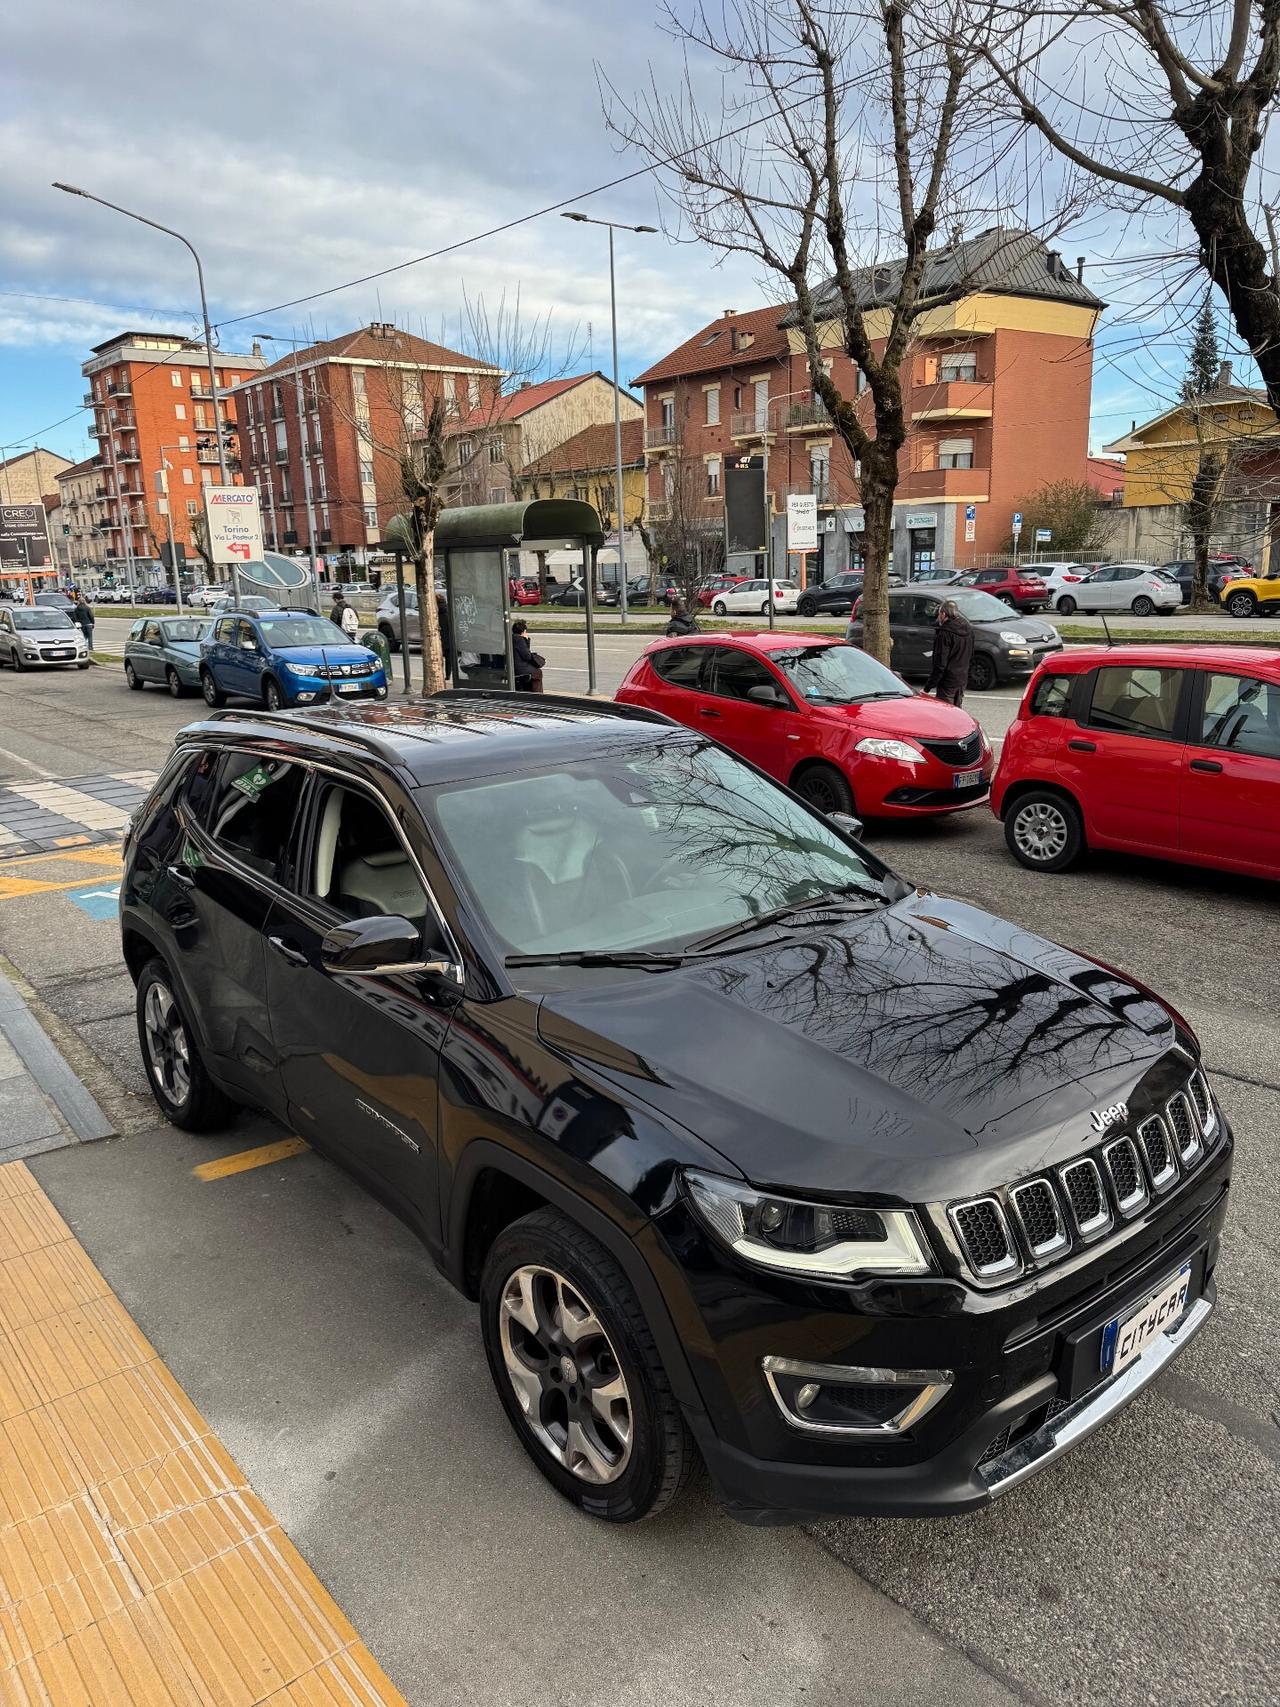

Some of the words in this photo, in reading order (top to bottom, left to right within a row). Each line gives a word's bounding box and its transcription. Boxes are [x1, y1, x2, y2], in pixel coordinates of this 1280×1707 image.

[210, 493, 254, 504] MERCATO
[4, 509, 33, 518] CREO
[1014, 514, 1020, 522] P
[223, 525, 249, 533] Torino
[1090, 1101, 1129, 1132] Jeep
[1120, 1283, 1188, 1360] CITYCAR
